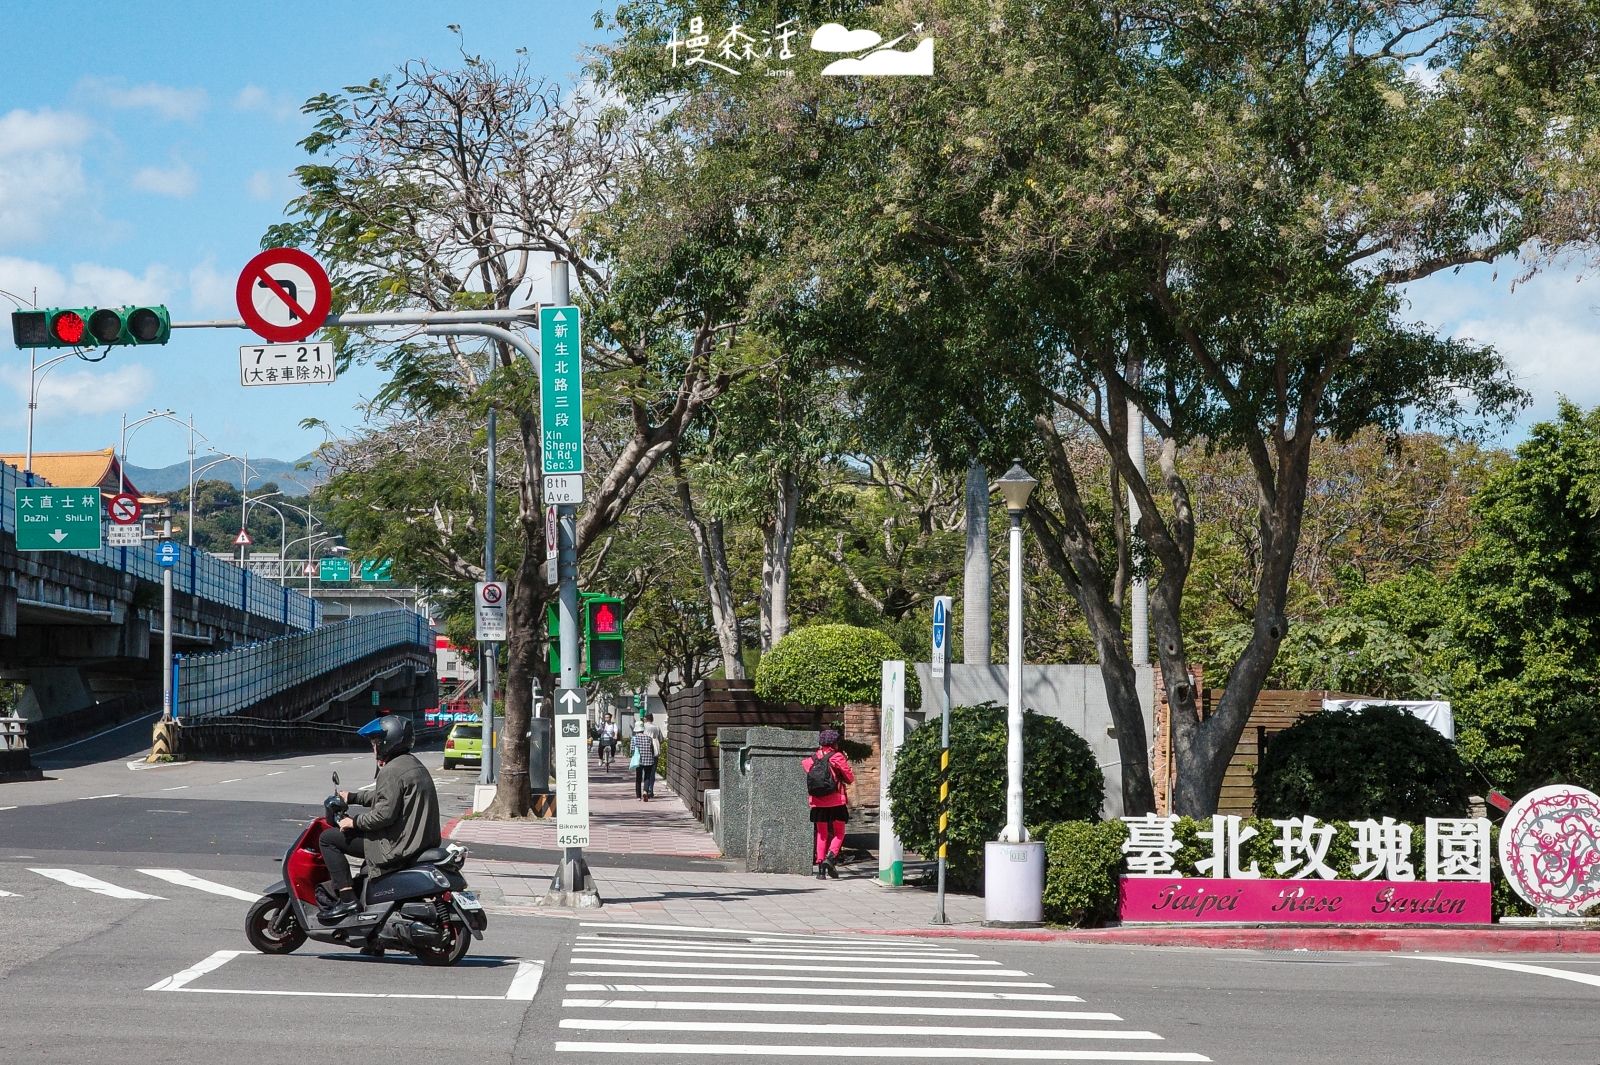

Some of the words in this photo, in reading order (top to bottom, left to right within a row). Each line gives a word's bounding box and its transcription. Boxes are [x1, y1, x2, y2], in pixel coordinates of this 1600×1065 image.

[244, 364, 332, 383] (大客車除外)
[554, 323, 569, 427] 新生北路三段
[546, 430, 562, 440] Xin
[546, 441, 577, 451] Sheng
[545, 451, 554, 460] N.
[557, 450, 573, 460] Rd.
[547, 478, 567, 489] 8th
[547, 491, 573, 502] Ave.
[23, 514, 49, 522] DaZhi
[65, 514, 93, 522] ShiLin
[565, 744, 579, 815] 河濱自行車道
[559, 835, 588, 845] 455m
[1120, 812, 1492, 883] 臺北玫瑰園
[1152, 884, 1242, 917] Taipei
[1272, 886, 1342, 912] Rose
[1371, 886, 1466, 914] Garden
